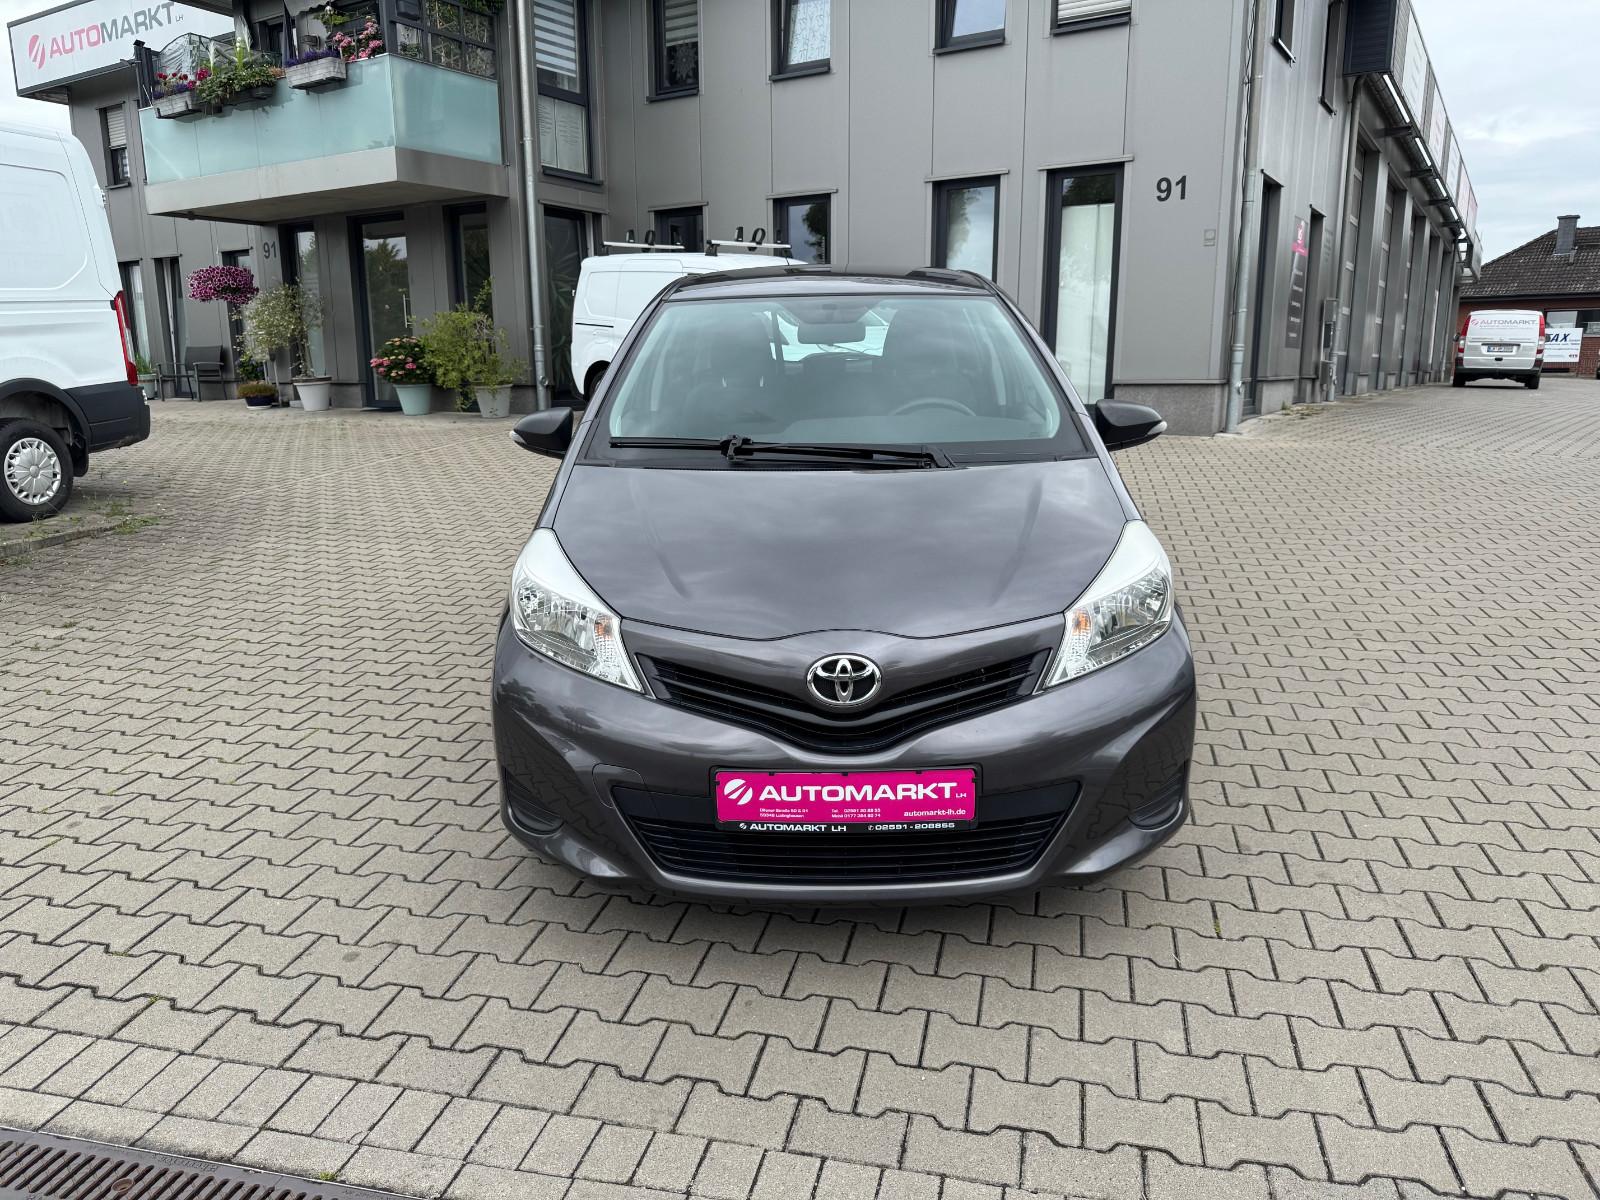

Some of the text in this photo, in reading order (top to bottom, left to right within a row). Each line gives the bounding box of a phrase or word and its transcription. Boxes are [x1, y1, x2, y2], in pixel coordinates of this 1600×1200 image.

[50, 2, 175, 59] AUTOMARKT
[1156, 175, 1187, 202] 91
[263, 241, 277, 259] 91
[759, 782, 957, 801] AUTOMARKT
[903, 808, 966, 817] automarkt-lh.de
[749, 823, 827, 832] AUTOMARKT
